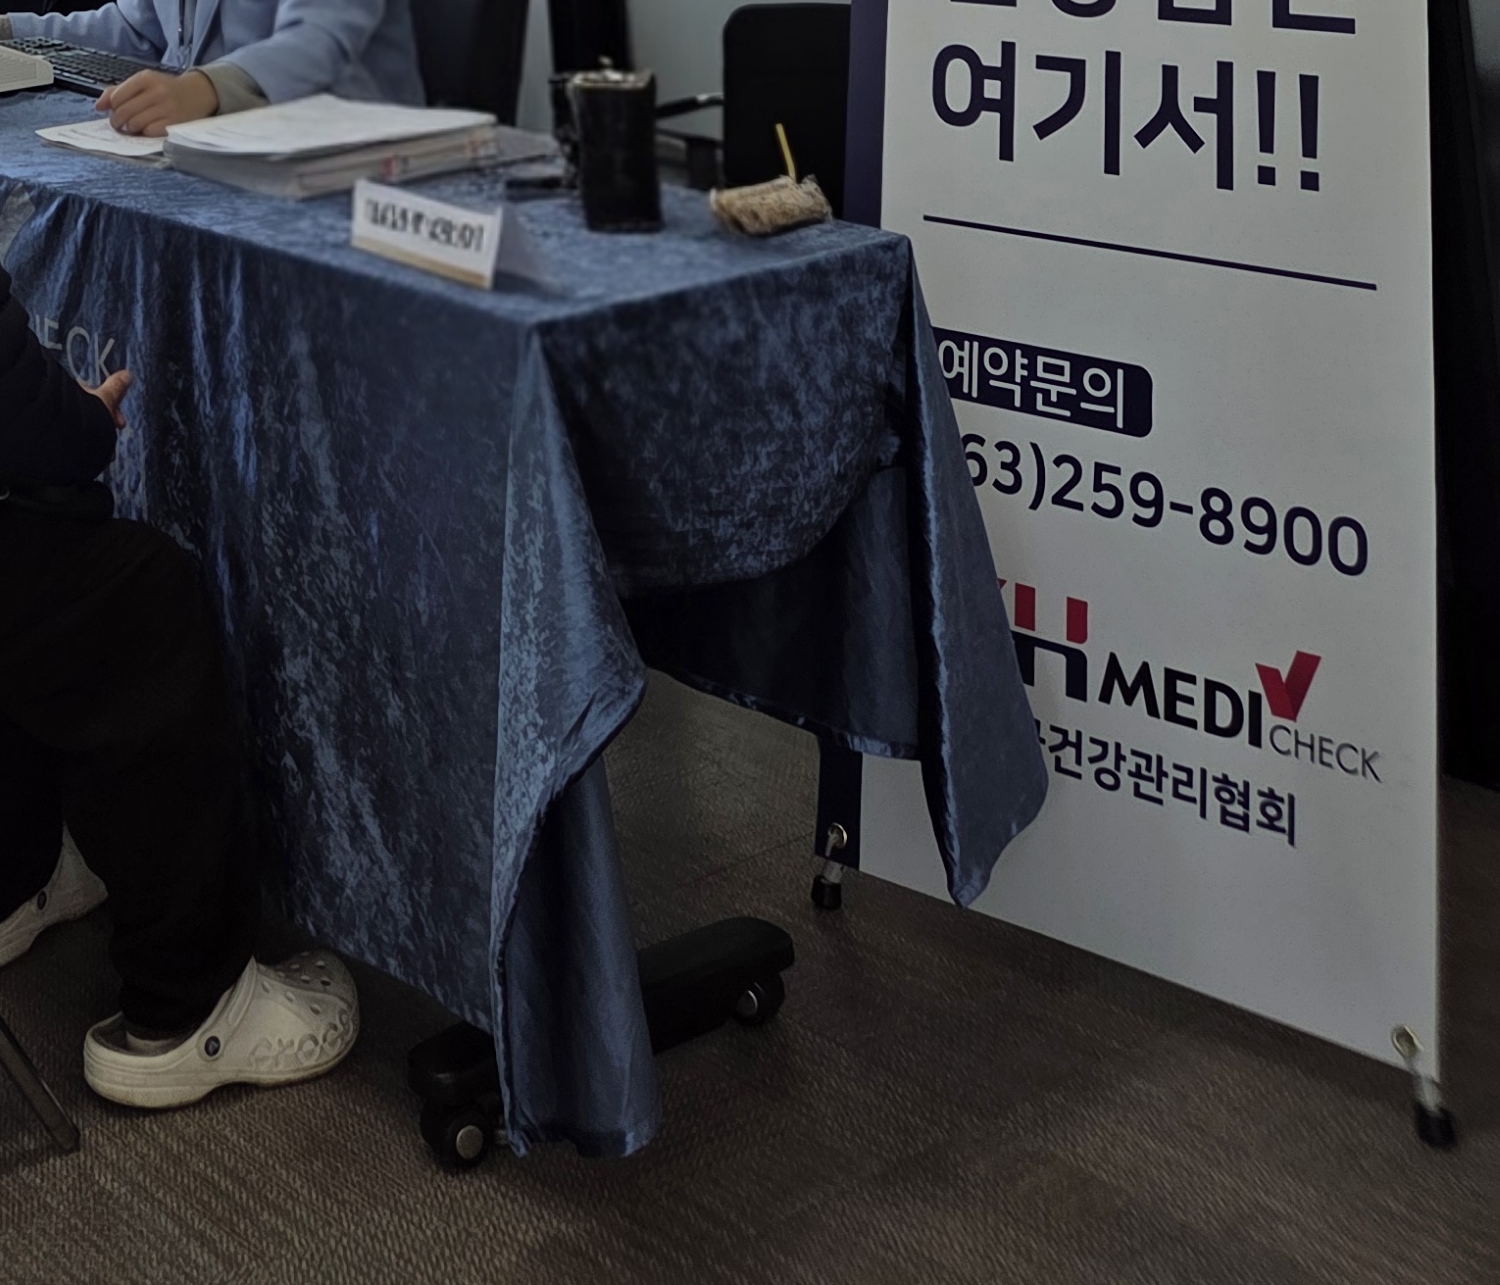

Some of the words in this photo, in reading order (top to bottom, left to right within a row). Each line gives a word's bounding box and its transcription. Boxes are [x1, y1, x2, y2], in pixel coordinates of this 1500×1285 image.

[932, 40, 1320, 192] 여기서!!
[938, 339, 1124, 428] 예약문의
[961, 433, 1369, 578] 63)259-8900
[997, 578, 1088, 703] H
[1034, 718, 1296, 847] 건강관리협회
